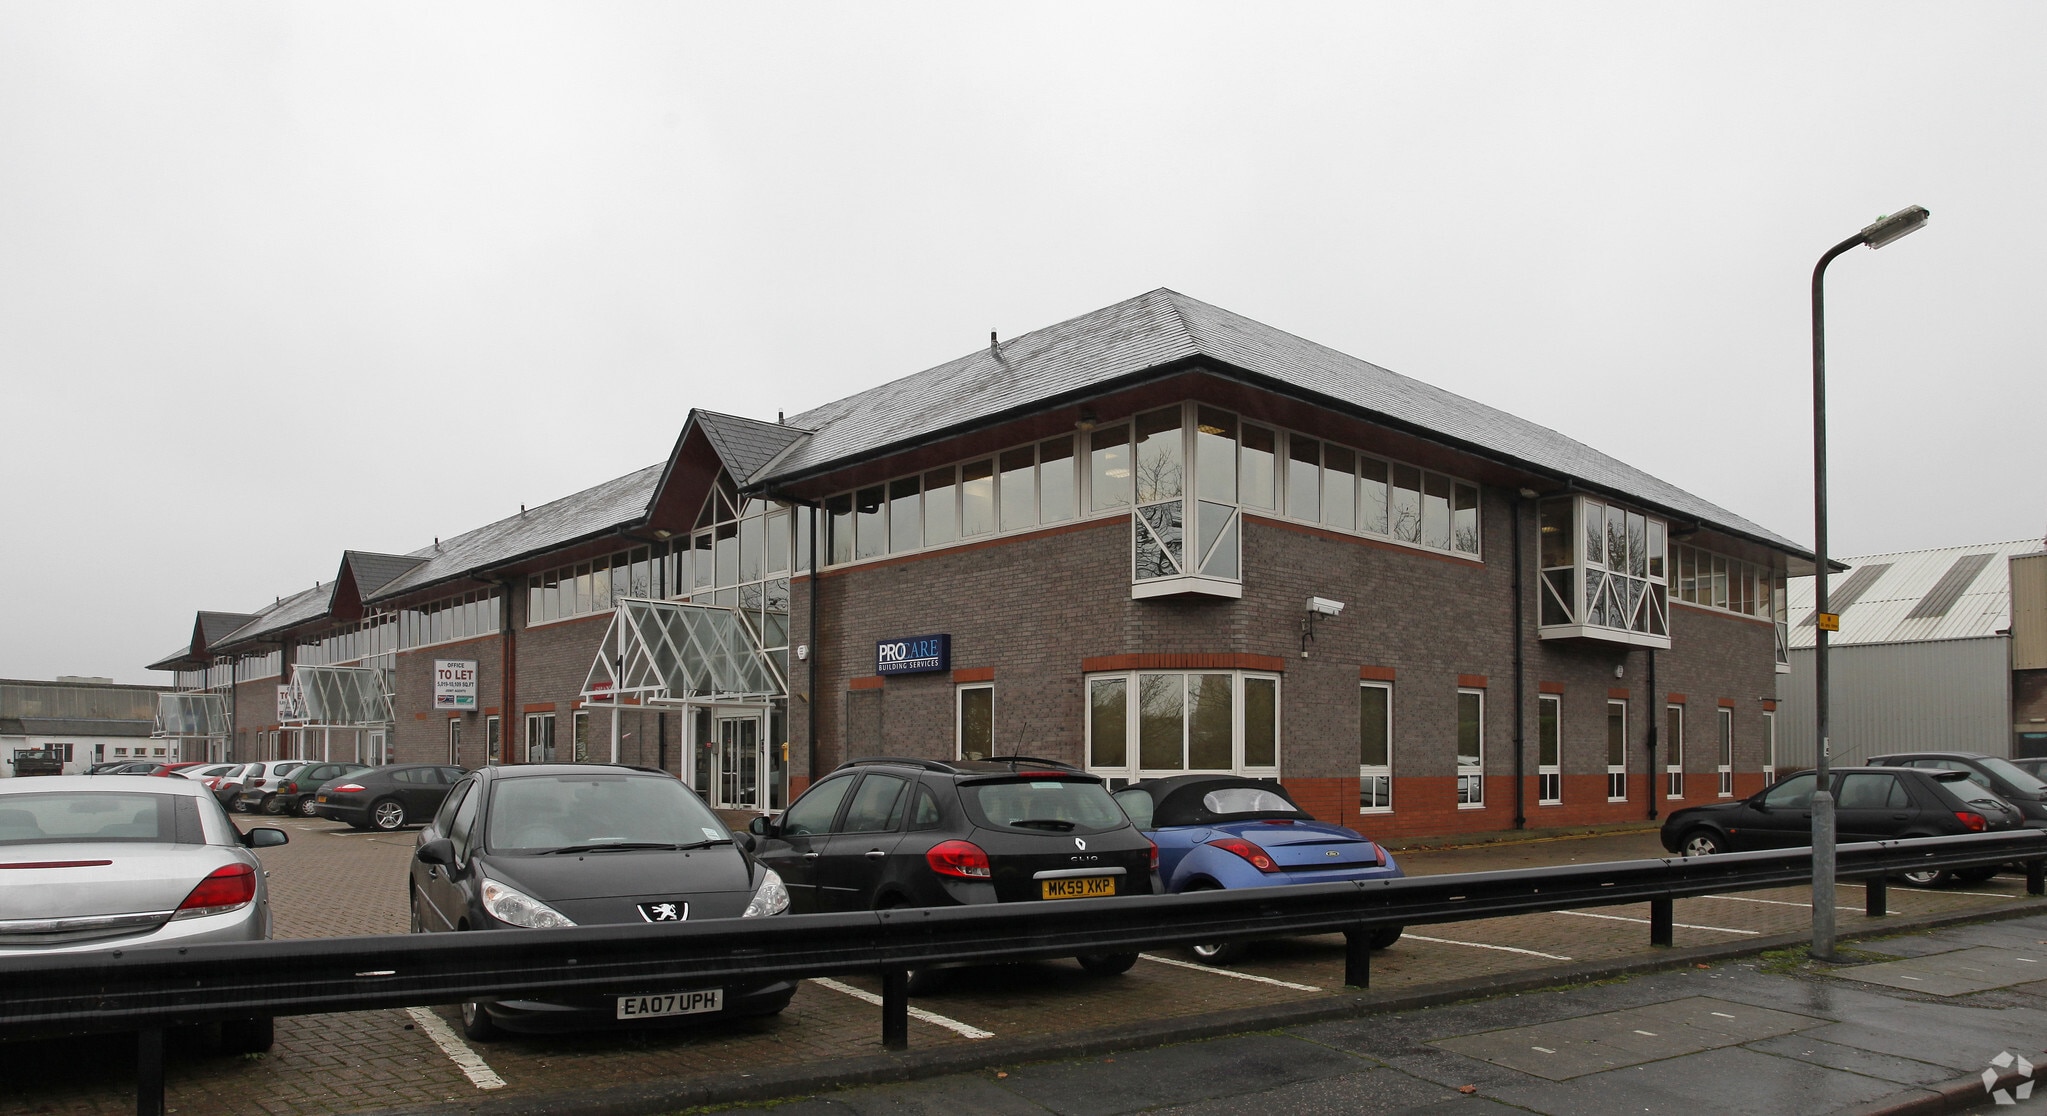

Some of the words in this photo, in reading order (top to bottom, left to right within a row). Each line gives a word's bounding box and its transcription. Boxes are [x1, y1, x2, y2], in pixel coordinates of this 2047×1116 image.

[879, 640, 939, 662] PROCARE
[879, 662, 907, 671] BUILDING
[909, 660, 939, 669] SERVICES
[438, 670, 452, 680] TO
[455, 670, 473, 680] LET
[1048, 880, 1084, 896] MK59
[1087, 879, 1110, 893] XKP
[624, 995, 676, 1015] EA07
[679, 992, 716, 1011] UPH
